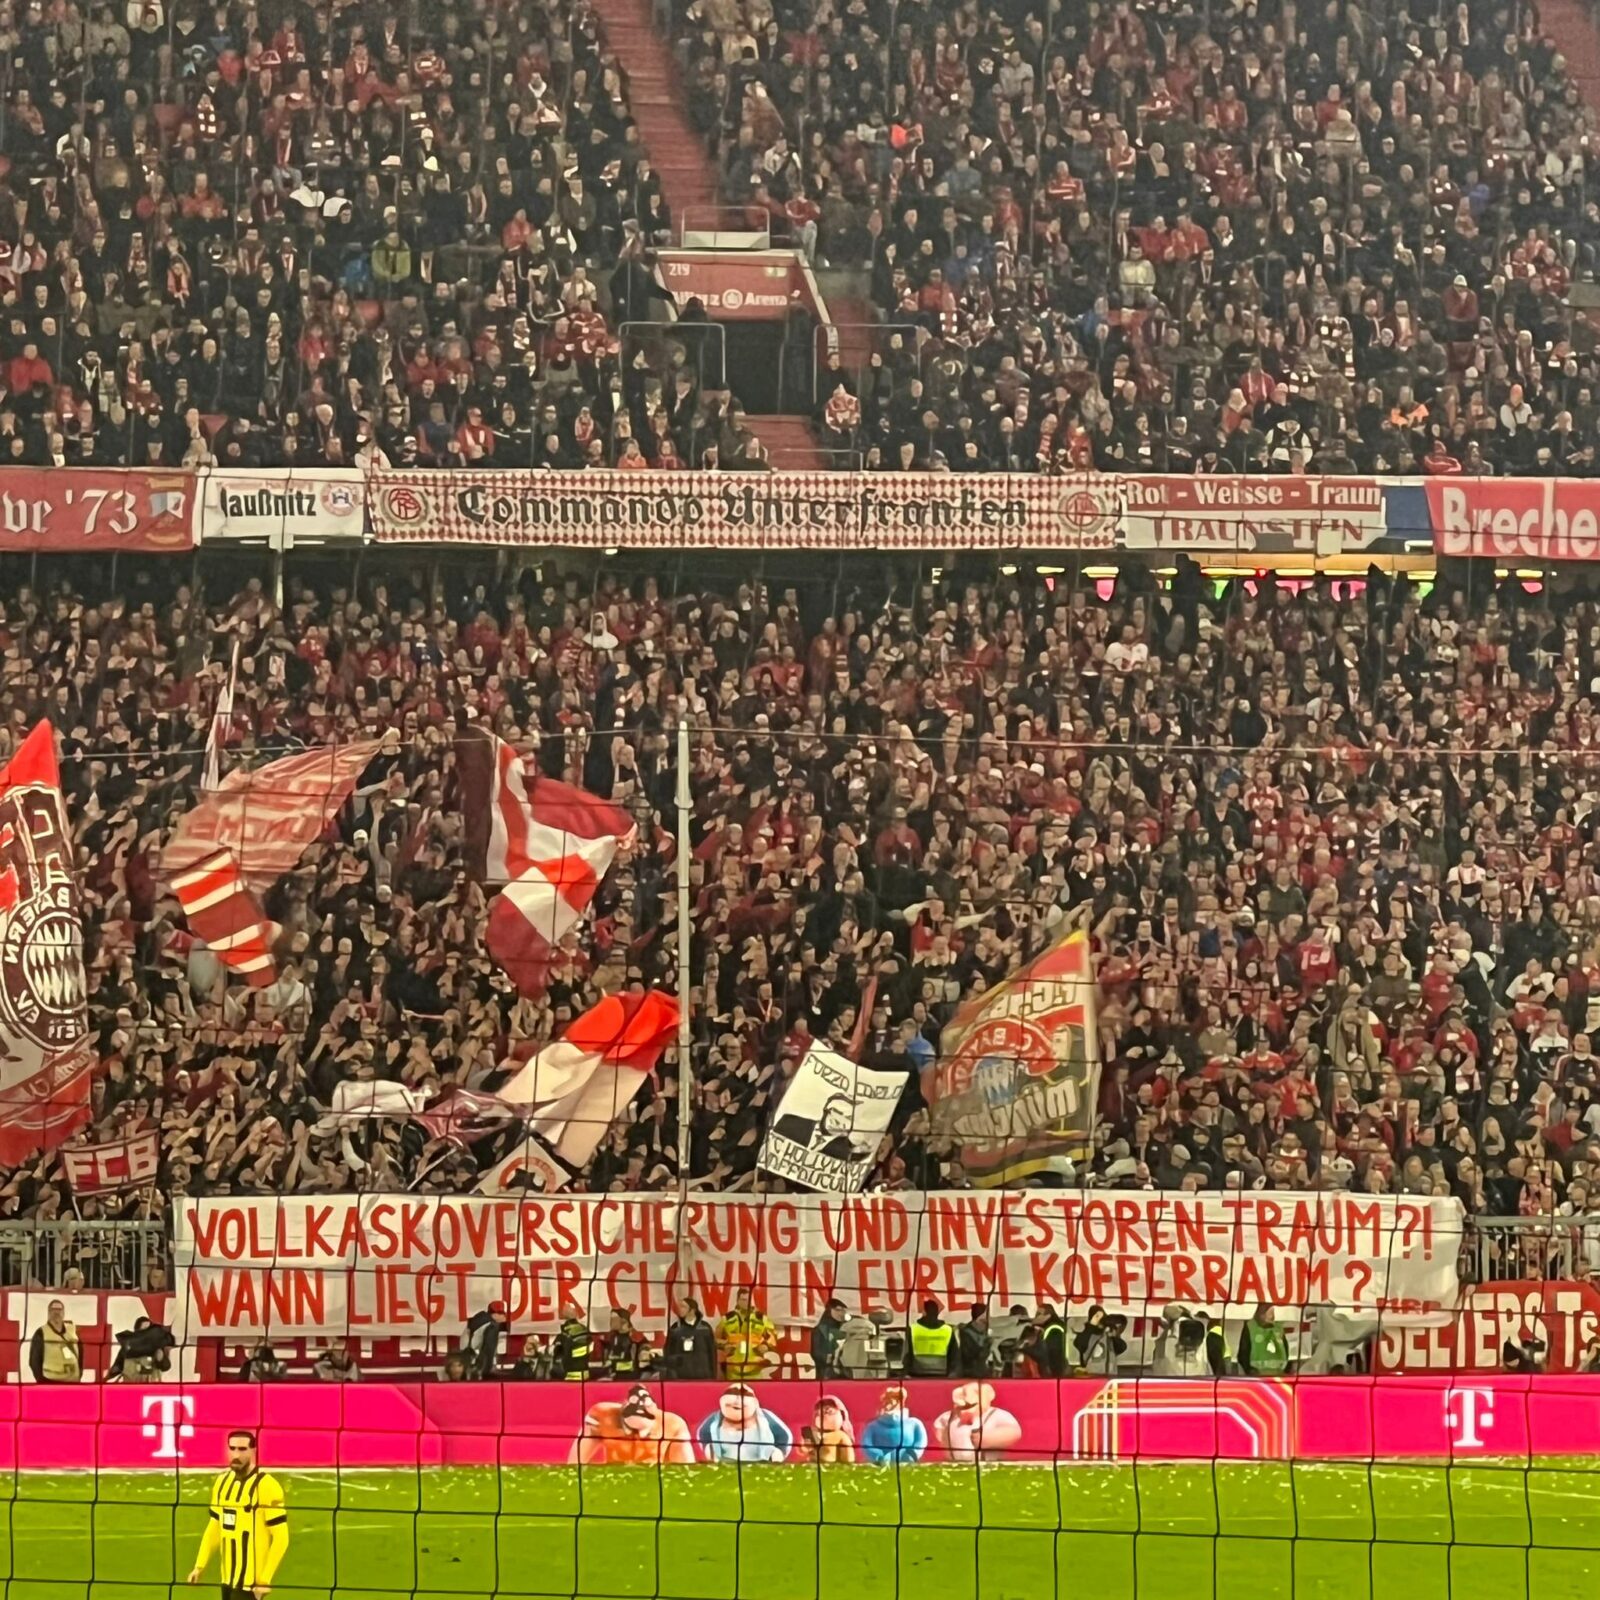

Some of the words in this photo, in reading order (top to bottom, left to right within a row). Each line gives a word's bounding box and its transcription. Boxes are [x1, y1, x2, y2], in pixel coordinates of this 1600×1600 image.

[668, 263, 691, 276] 219
[744, 291, 787, 306] Arena
[65, 488, 138, 535] '73
[457, 485, 703, 525] Commando
[722, 482, 1027, 538] Unterfranken
[1126, 480, 1169, 505] Rot
[1194, 480, 1283, 505] Weisse
[1443, 486, 1600, 559] Breche
[64, 1134, 157, 1190] FCB
[187, 1201, 798, 1260] VOLLKASKOVERSICHERUNG
[820, 1198, 909, 1252] UND
[188, 1267, 324, 1327] WANN
[349, 1262, 476, 1324] LIEGT
[502, 1260, 585, 1322] DER
[607, 1260, 767, 1320] CLOWN
[789, 1260, 833, 1317] IN
[858, 1254, 1009, 1314] EUREM
